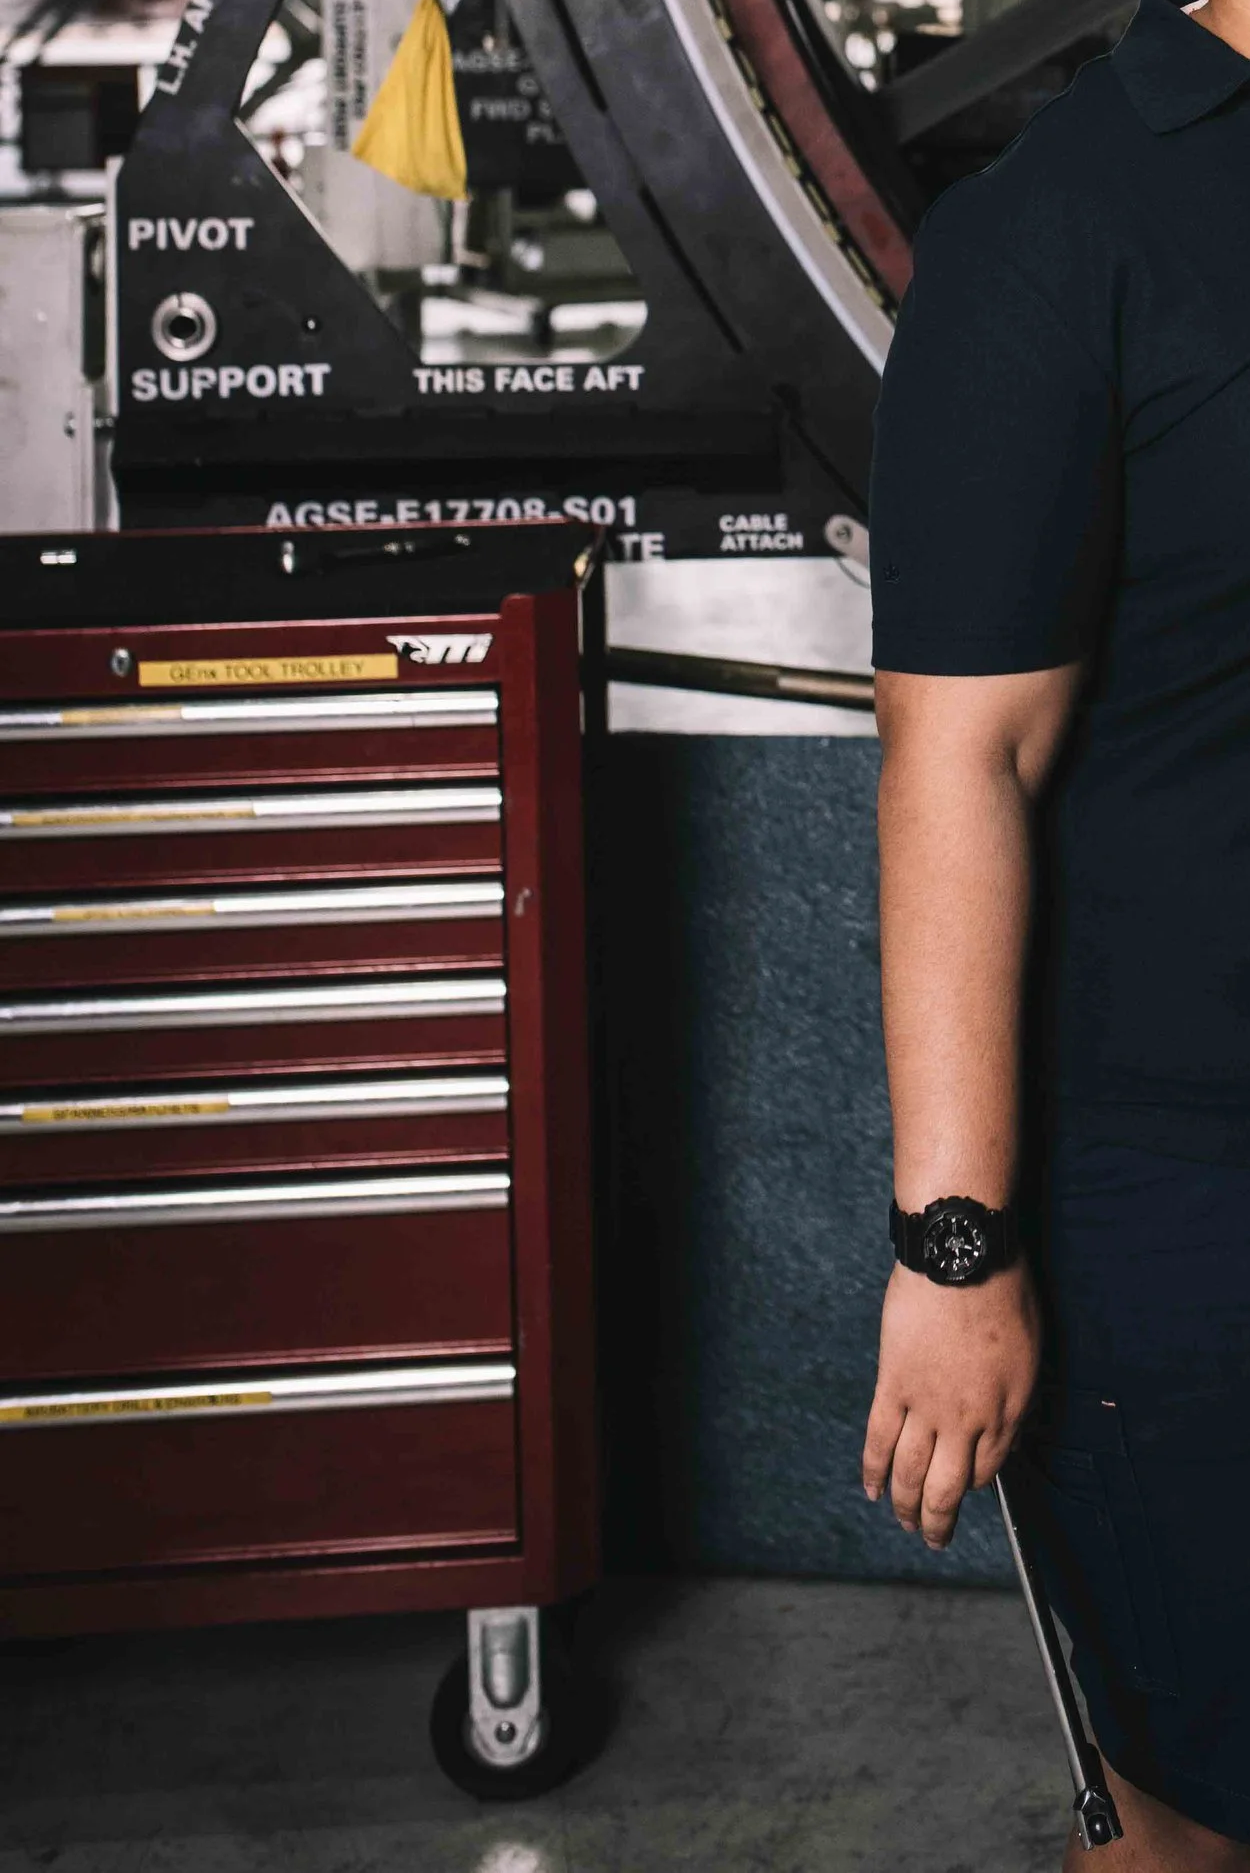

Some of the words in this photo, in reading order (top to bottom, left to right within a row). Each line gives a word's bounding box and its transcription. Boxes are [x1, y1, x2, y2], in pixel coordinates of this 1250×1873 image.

[128, 218, 254, 251] PIVOT
[131, 363, 331, 402] SUPPORT
[412, 367, 486, 394] THIS
[494, 366, 575, 392] FACE
[583, 365, 644, 391] AFT
[719, 513, 788, 532] CABLE
[720, 531, 804, 551] ATTACH
[224, 664, 272, 680] TOOL
[281, 661, 365, 679] TROLLEY
